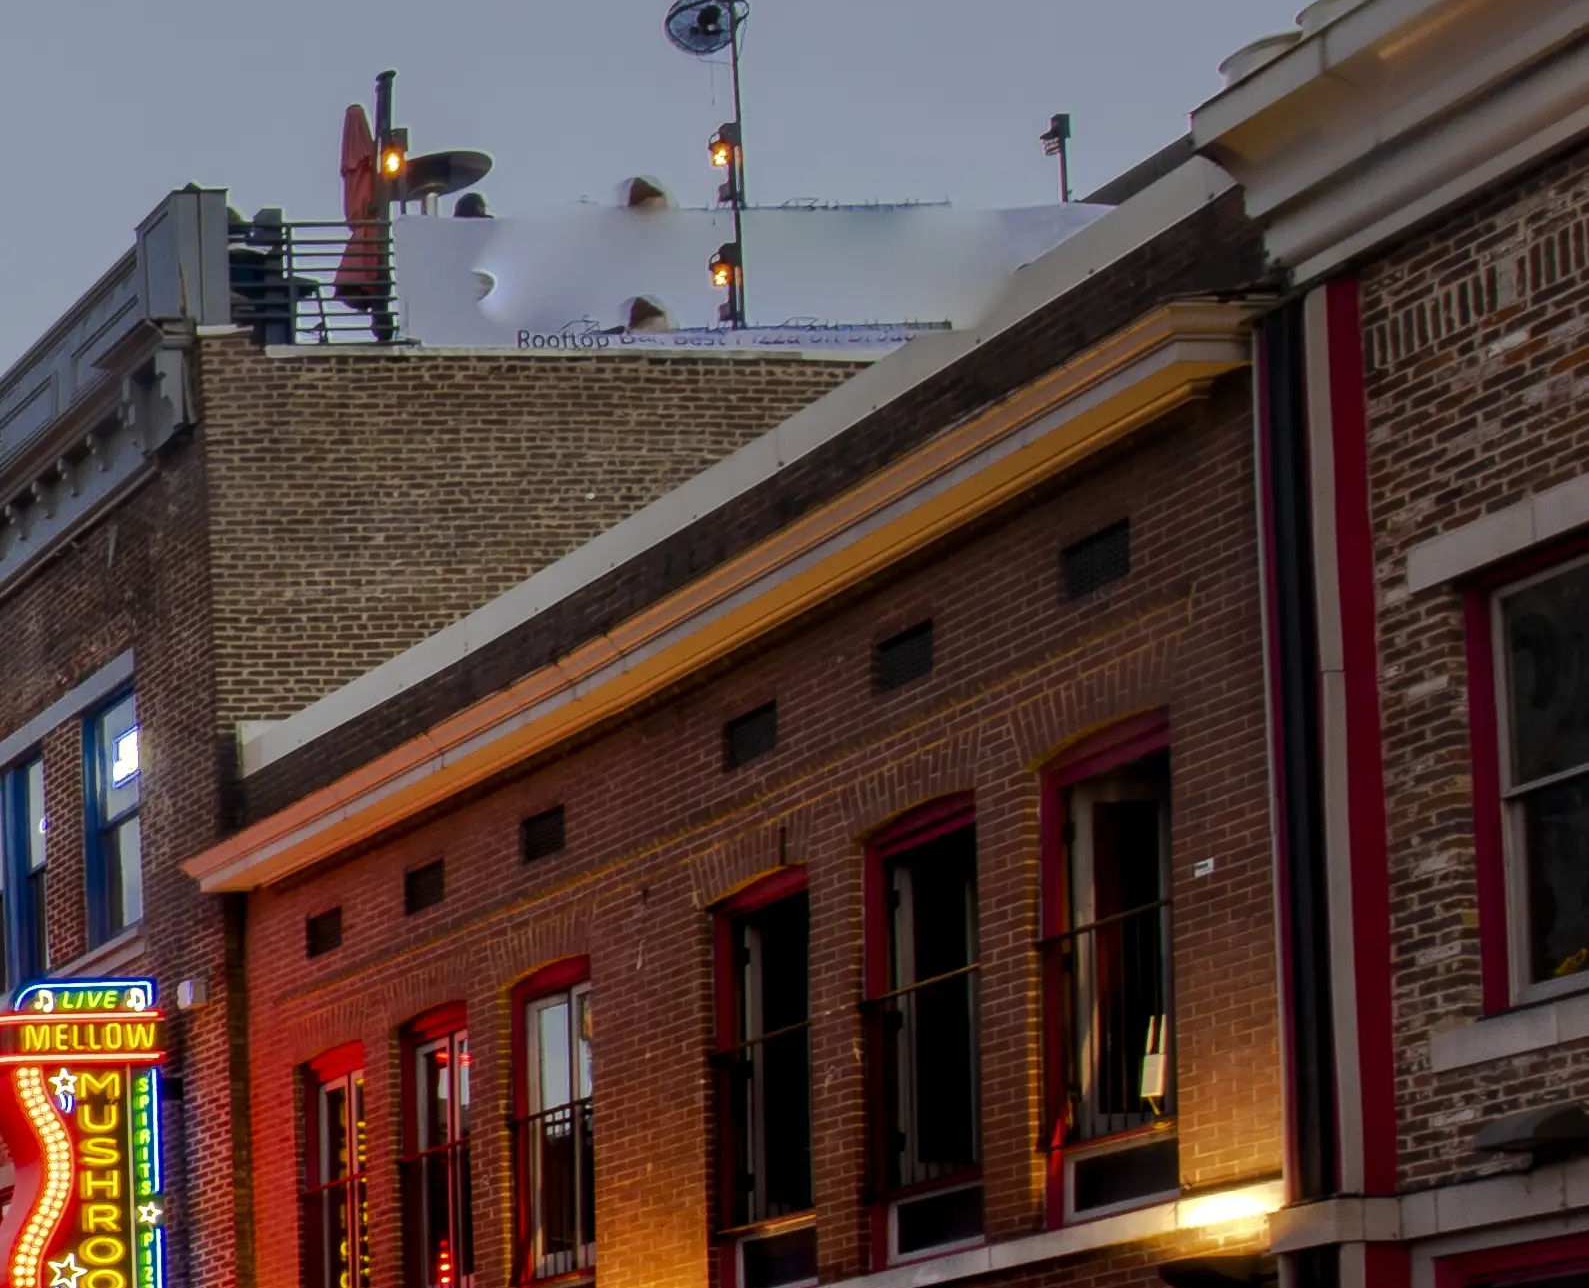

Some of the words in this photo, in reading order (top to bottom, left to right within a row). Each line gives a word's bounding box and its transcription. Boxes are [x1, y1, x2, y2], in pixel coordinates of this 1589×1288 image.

[61, 991, 117, 1009] LIVE
[23, 1023, 156, 1050] MELLOW
[134, 1076, 152, 1196] SPIRITS
